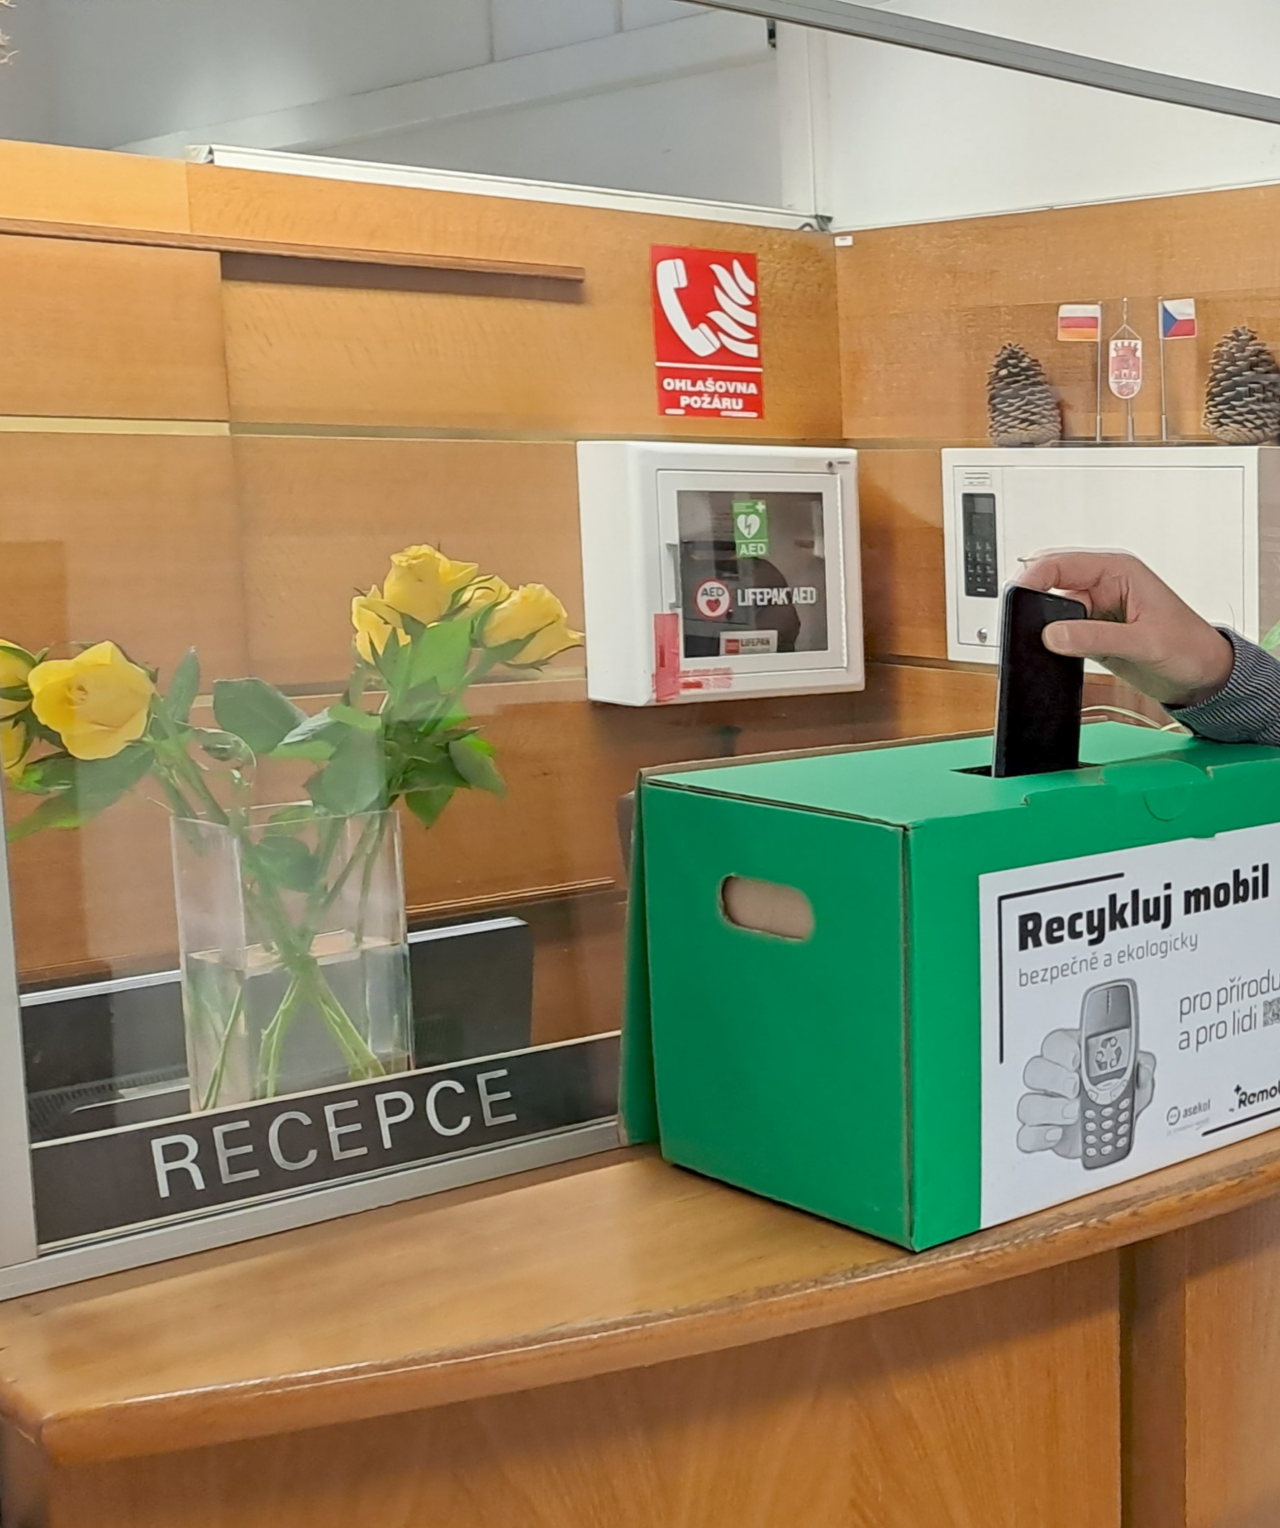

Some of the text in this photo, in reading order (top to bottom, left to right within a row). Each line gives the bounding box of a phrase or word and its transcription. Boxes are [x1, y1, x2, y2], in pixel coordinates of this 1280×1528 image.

[662, 377, 758, 394] OHLAŠOVNA
[680, 394, 743, 410] POŽÁRU
[739, 543, 766, 555] AED
[700, 586, 725, 597] AED
[737, 587, 816, 606] LIFEPAK AED
[1017, 863, 1270, 952] Recykluj mobil
[1018, 931, 1199, 988] bezpečně a ekologicky
[1180, 991, 1212, 1024] pro
[1178, 1004, 1257, 1053] a pro lidi
[151, 1069, 518, 1198] RECEPCE
